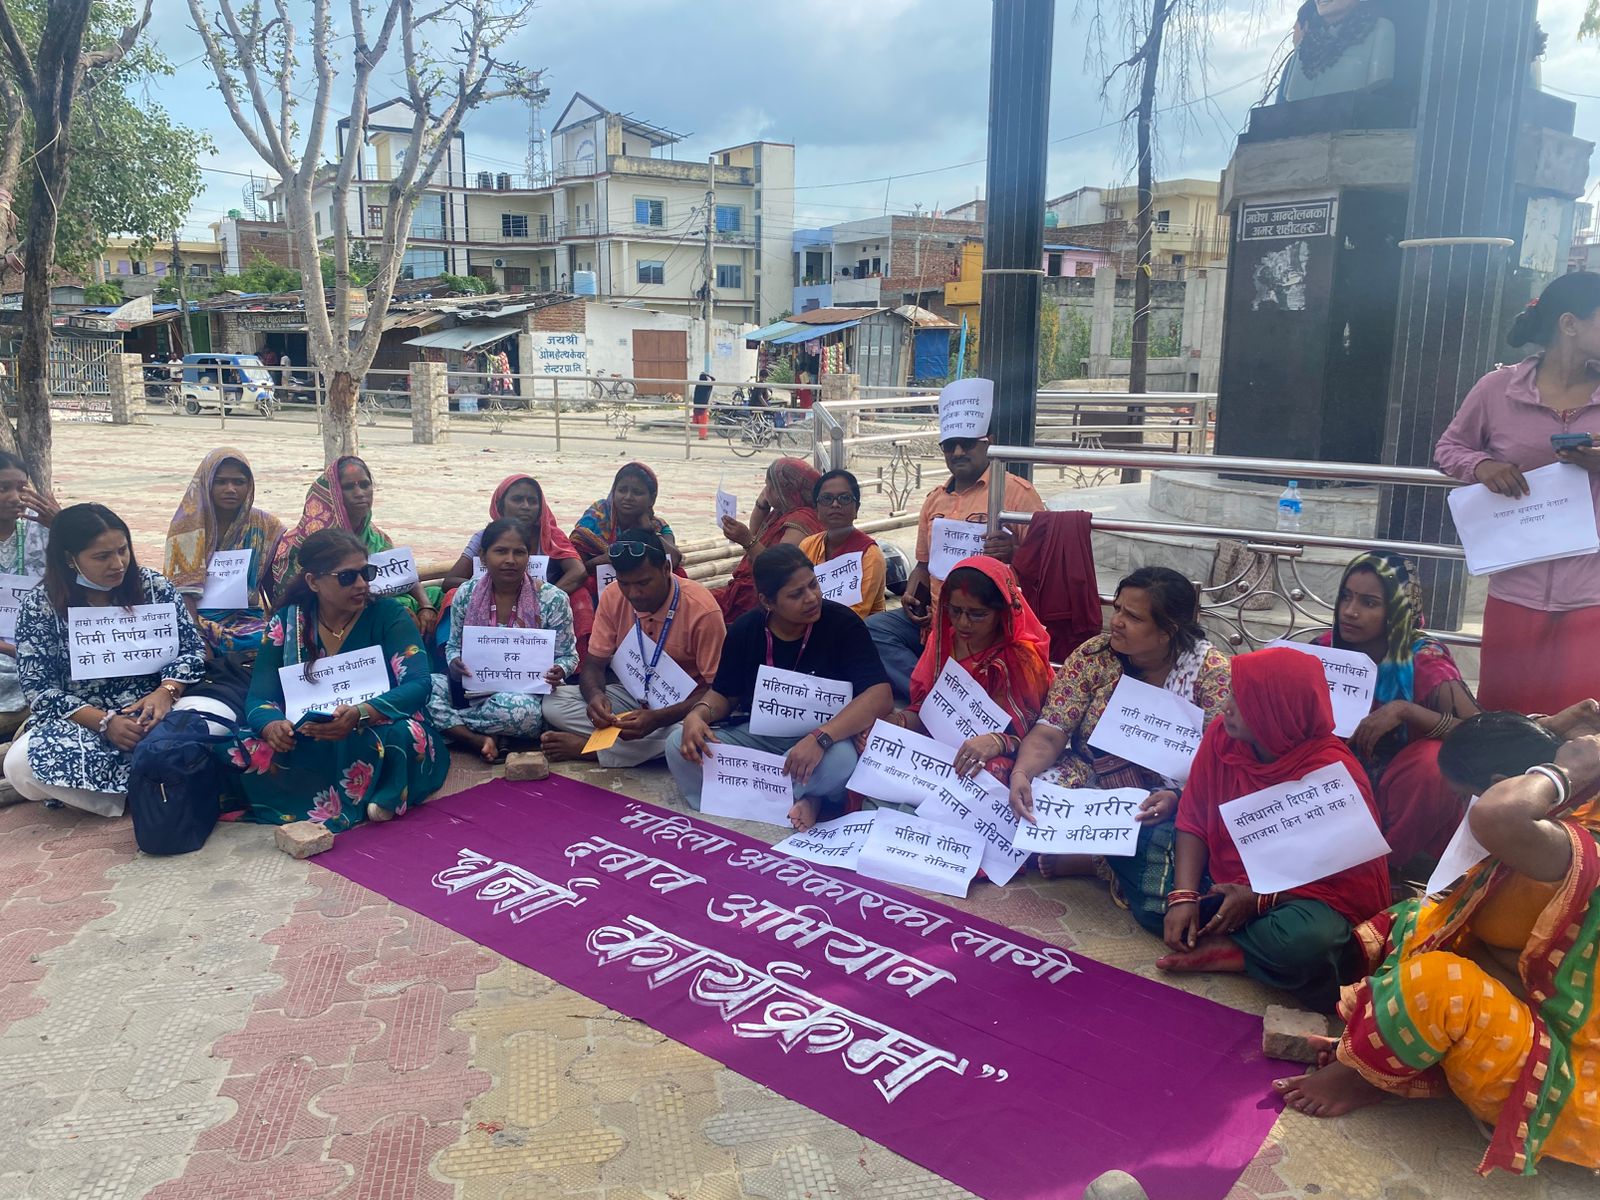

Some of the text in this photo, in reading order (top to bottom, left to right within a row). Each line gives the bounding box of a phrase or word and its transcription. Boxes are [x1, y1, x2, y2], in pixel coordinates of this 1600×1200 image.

[1246, 211, 1268, 223] मधेश
[1252, 225, 1274, 236] अमर
[95, 616, 115, 626] शरीर
[75, 623, 173, 646] तिमी निर्णय गर्ने
[477, 634, 509, 645] महिलाको
[78, 651, 95, 666] को
[102, 649, 116, 664] हो
[122, 647, 163, 661] सरकार
[504, 652, 520, 662] हक
[526, 671, 542, 681] गर
[332, 680, 351, 694] हक
[762, 676, 847, 707] महिलाको नेतृत्व
[1342, 683, 1360, 697] गर
[758, 698, 807, 721] स्वीकार
[932, 689, 957, 719] मानव
[944, 672, 1002, 731] महिला अधिकार
[1121, 706, 1141, 720] नारी
[869, 735, 955, 779] हाम्रो एकता
[1084, 796, 1138, 816] शरीर
[1286, 785, 1320, 809] दिएको
[938, 787, 1025, 864] मानव अधिकार
[1026, 823, 1133, 841] मेरो अधिकार
[1238, 823, 1279, 847] कागजमा
[1280, 816, 1302, 831] किन
[1304, 803, 1326, 822] भयो
[894, 825, 972, 861] महिला रोकिए
[726, 848, 953, 937] अधिकारका
[950, 925, 1084, 985] लागी
[706, 894, 957, 998] अभियान
